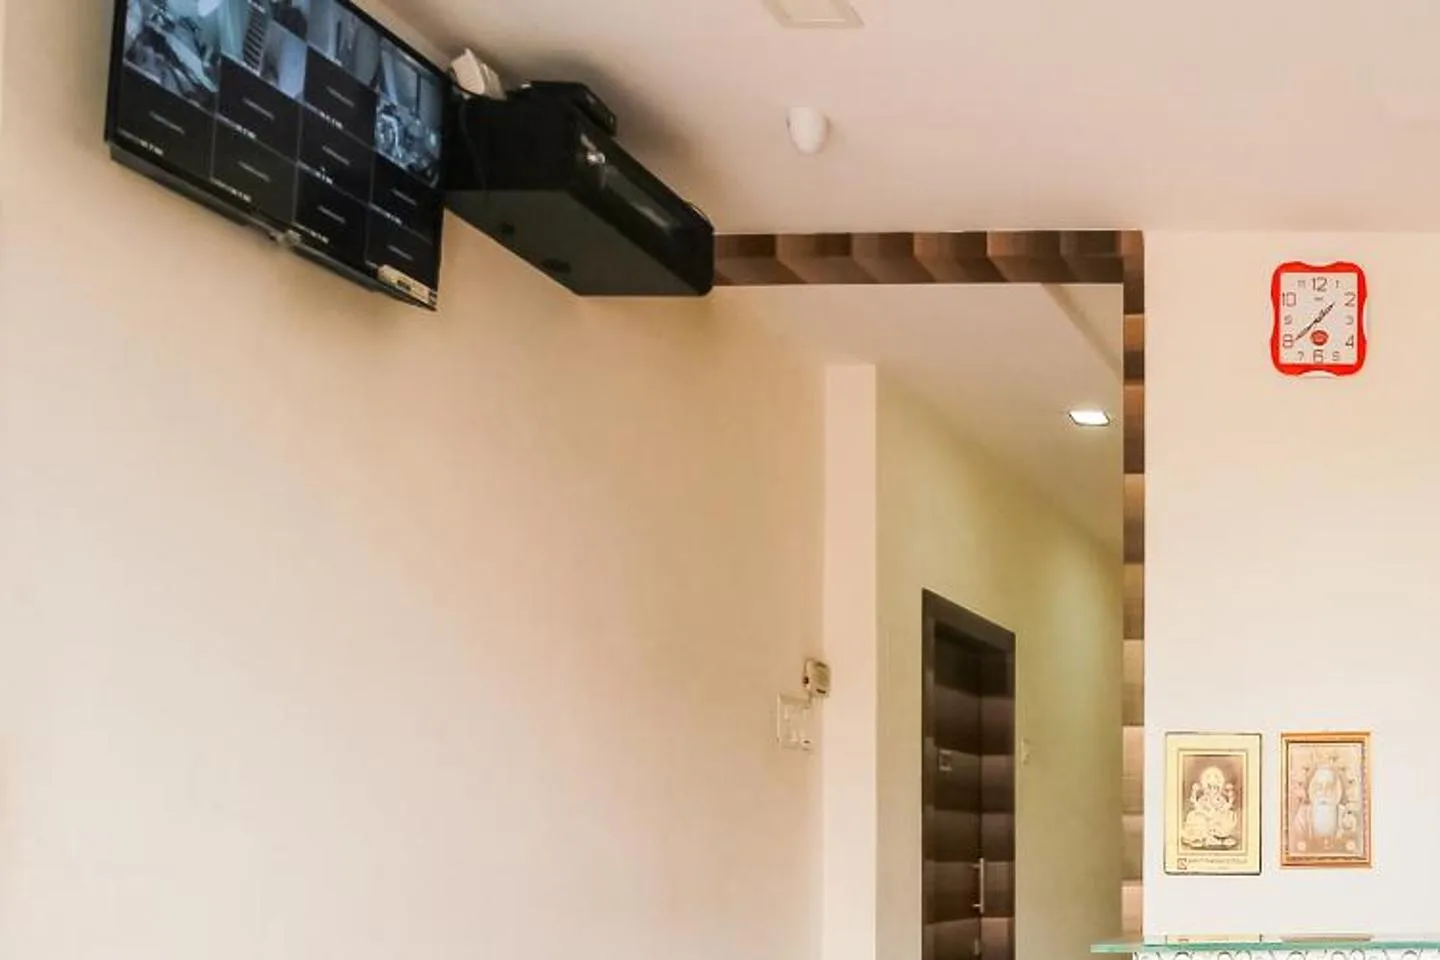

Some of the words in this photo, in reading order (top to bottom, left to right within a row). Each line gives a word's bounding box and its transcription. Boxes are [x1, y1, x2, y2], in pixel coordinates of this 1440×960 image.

[1312, 276, 1328, 292] 12
[1282, 291, 1297, 307] 10
[1344, 291, 1356, 307] 2
[1284, 314, 1293, 325] 9
[1345, 315, 1354, 325] 3
[1282, 334, 1294, 349] 8
[1345, 335, 1354, 349] 4
[1297, 351, 1305, 361] 7
[1313, 349, 1324, 364] 6
[1332, 351, 1341, 361] 5
